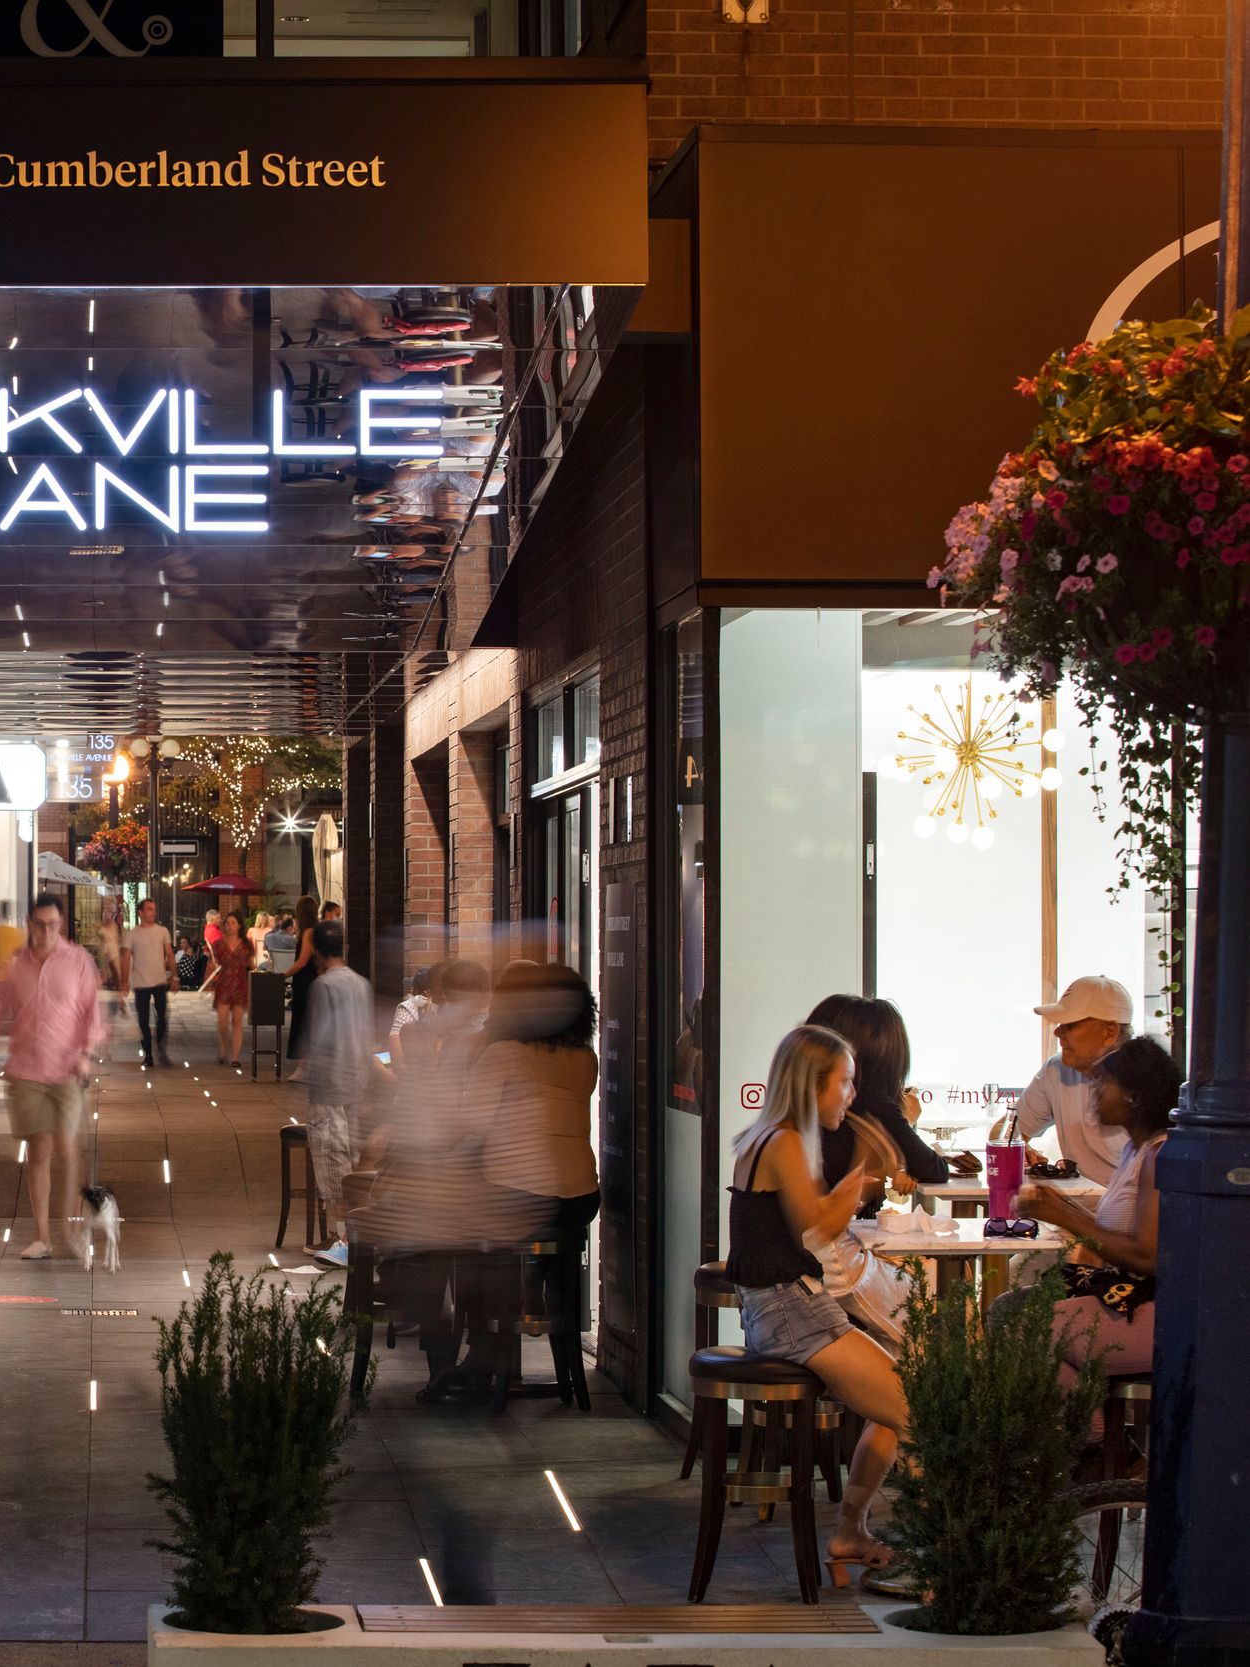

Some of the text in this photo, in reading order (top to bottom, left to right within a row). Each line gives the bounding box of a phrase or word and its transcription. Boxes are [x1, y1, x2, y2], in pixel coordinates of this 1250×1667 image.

[262, 152, 387, 188] Street
[89, 735, 114, 750] 135
[85, 753, 114, 762] AVENUE
